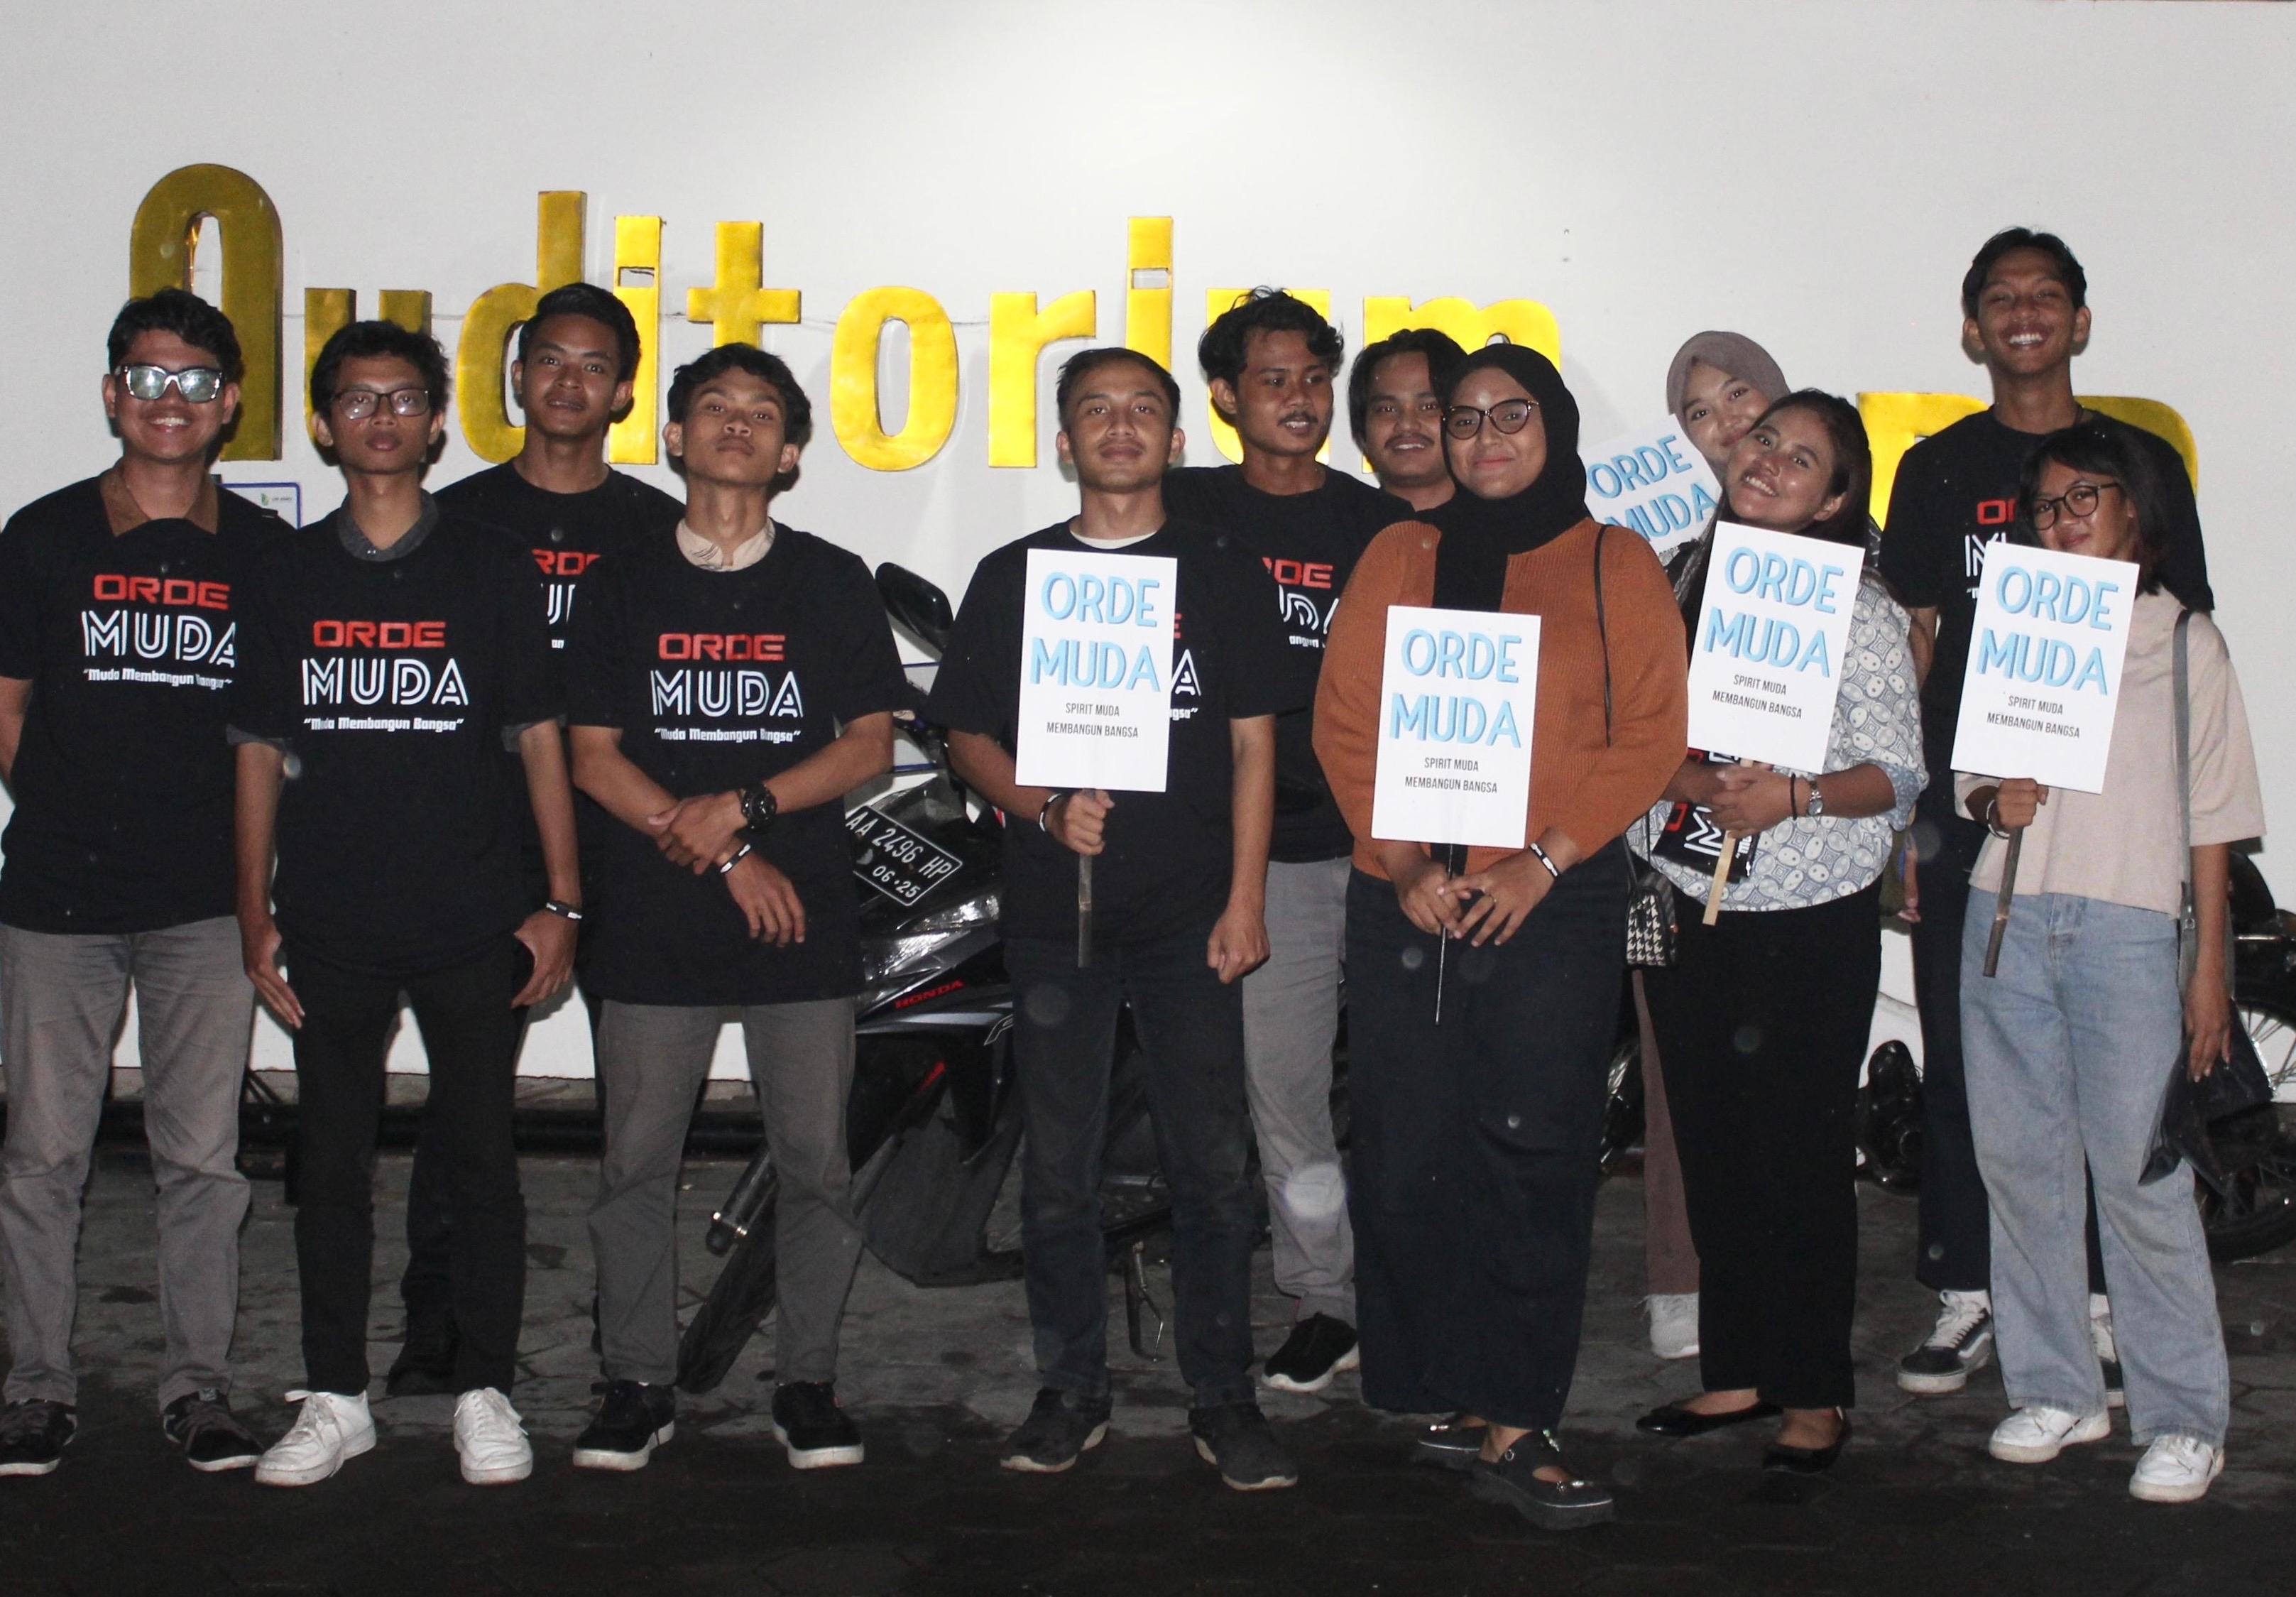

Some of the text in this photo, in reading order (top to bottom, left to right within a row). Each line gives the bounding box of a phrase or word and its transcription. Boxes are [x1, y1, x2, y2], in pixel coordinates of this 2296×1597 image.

[1586, 434, 1693, 498] ORDE
[94, 574, 231, 611] ORDE
[1724, 546, 1844, 614] ORDE
[1041, 572, 1160, 628] ORDE
[1996, 565, 2119, 631] ORDE
[82, 609, 236, 668] MUDA
[313, 620, 447, 649] ORDE
[658, 633, 786, 662] ORDE
[1703, 606, 1830, 678] MUDA
[1029, 636, 1161, 692] MUDA
[1401, 628, 1521, 683] ORDE
[1976, 626, 2108, 696] MUDA
[122, 667, 194, 687] Membangun
[302, 658, 469, 706] MUDA
[650, 669, 804, 718] MUDA
[1733, 674, 1787, 696] SPIRIT MUDA
[1065, 702, 1120, 717] SPIRIT MUDA
[1389, 692, 1521, 748] MUDA
[1712, 690, 1802, 719] MEMBANGUN BANGSA
[2008, 695, 2063, 715] SPIRIT MUDA
[338, 716, 410, 732] Membangun
[689, 727, 758, 743] Membangun
[1046, 721, 1139, 738] MEMBANGUN BANGSA
[1986, 712, 2080, 738] MEMBANGUN BANGSA
[1424, 757, 1479, 771] SPIRIT MUDA
[1404, 776, 1497, 793] MEMBANGUN BANGSA
[845, 812, 952, 879] AA 2496 HP
[896, 981, 964, 1008] HONDA
